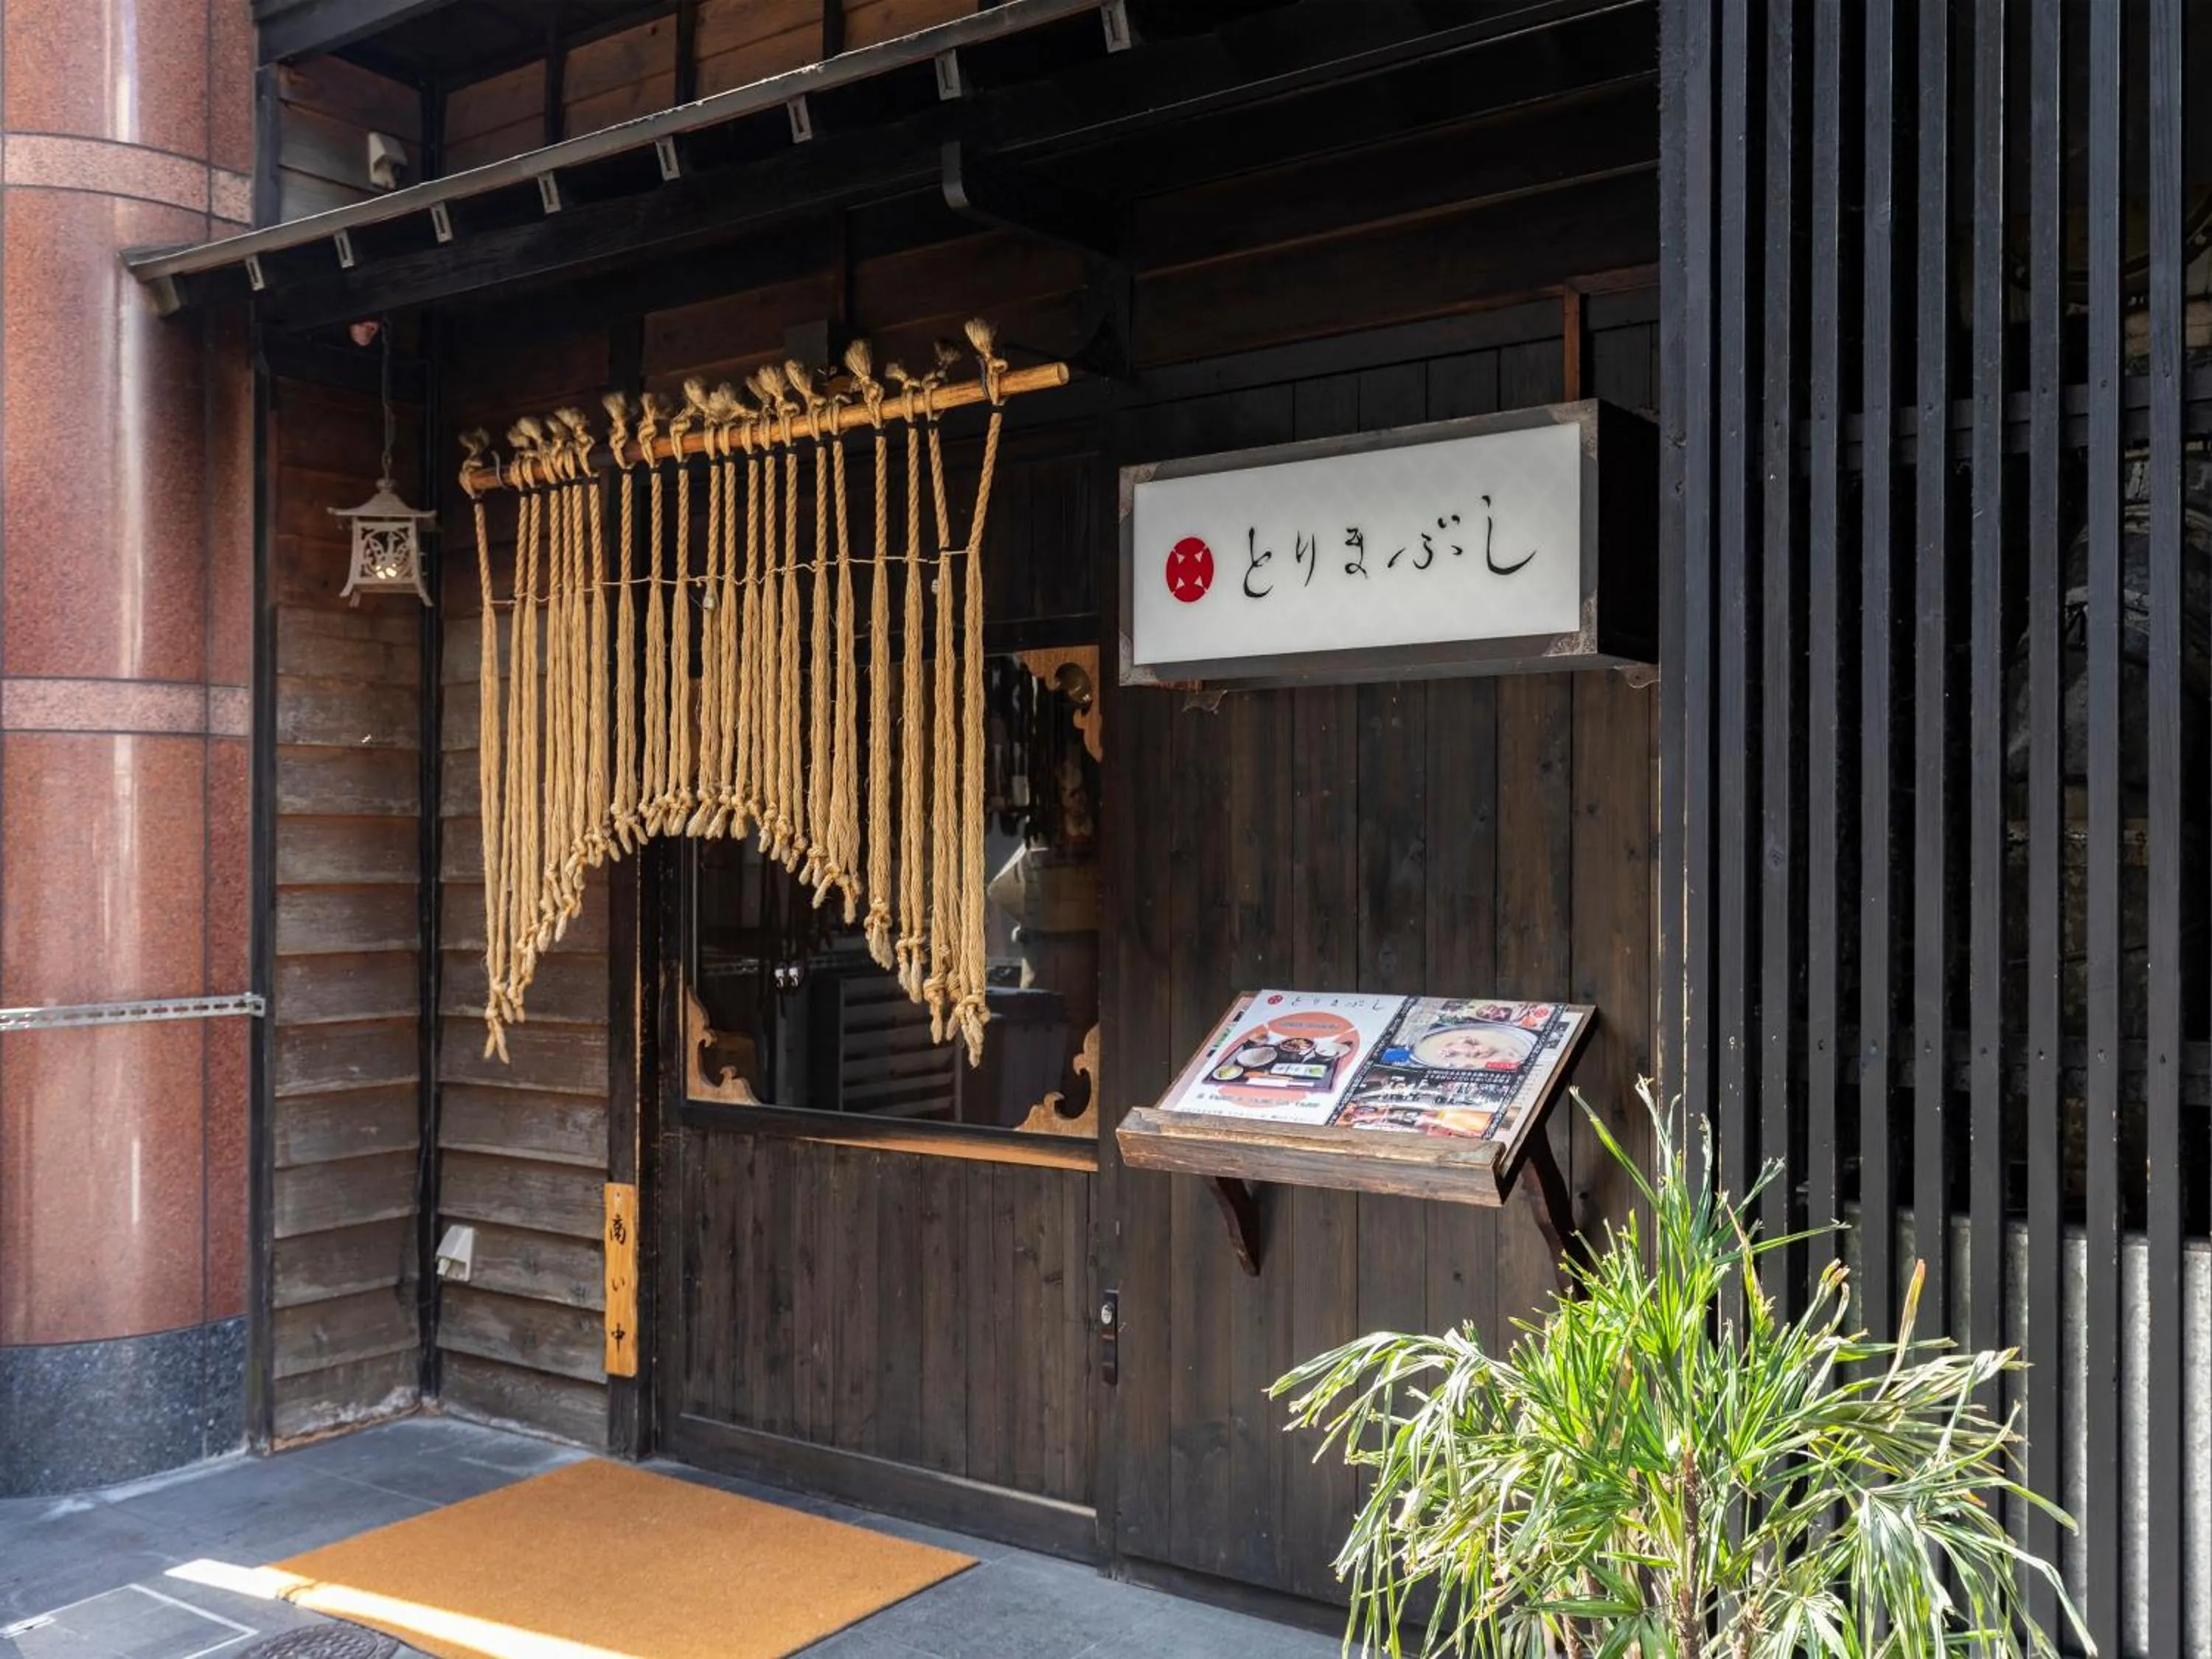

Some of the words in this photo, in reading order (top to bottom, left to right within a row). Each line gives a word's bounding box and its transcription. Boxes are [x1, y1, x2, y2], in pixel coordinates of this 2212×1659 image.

[1243, 495, 1537, 598] とりまぶし
[611, 1214, 626, 1353] 商い中
